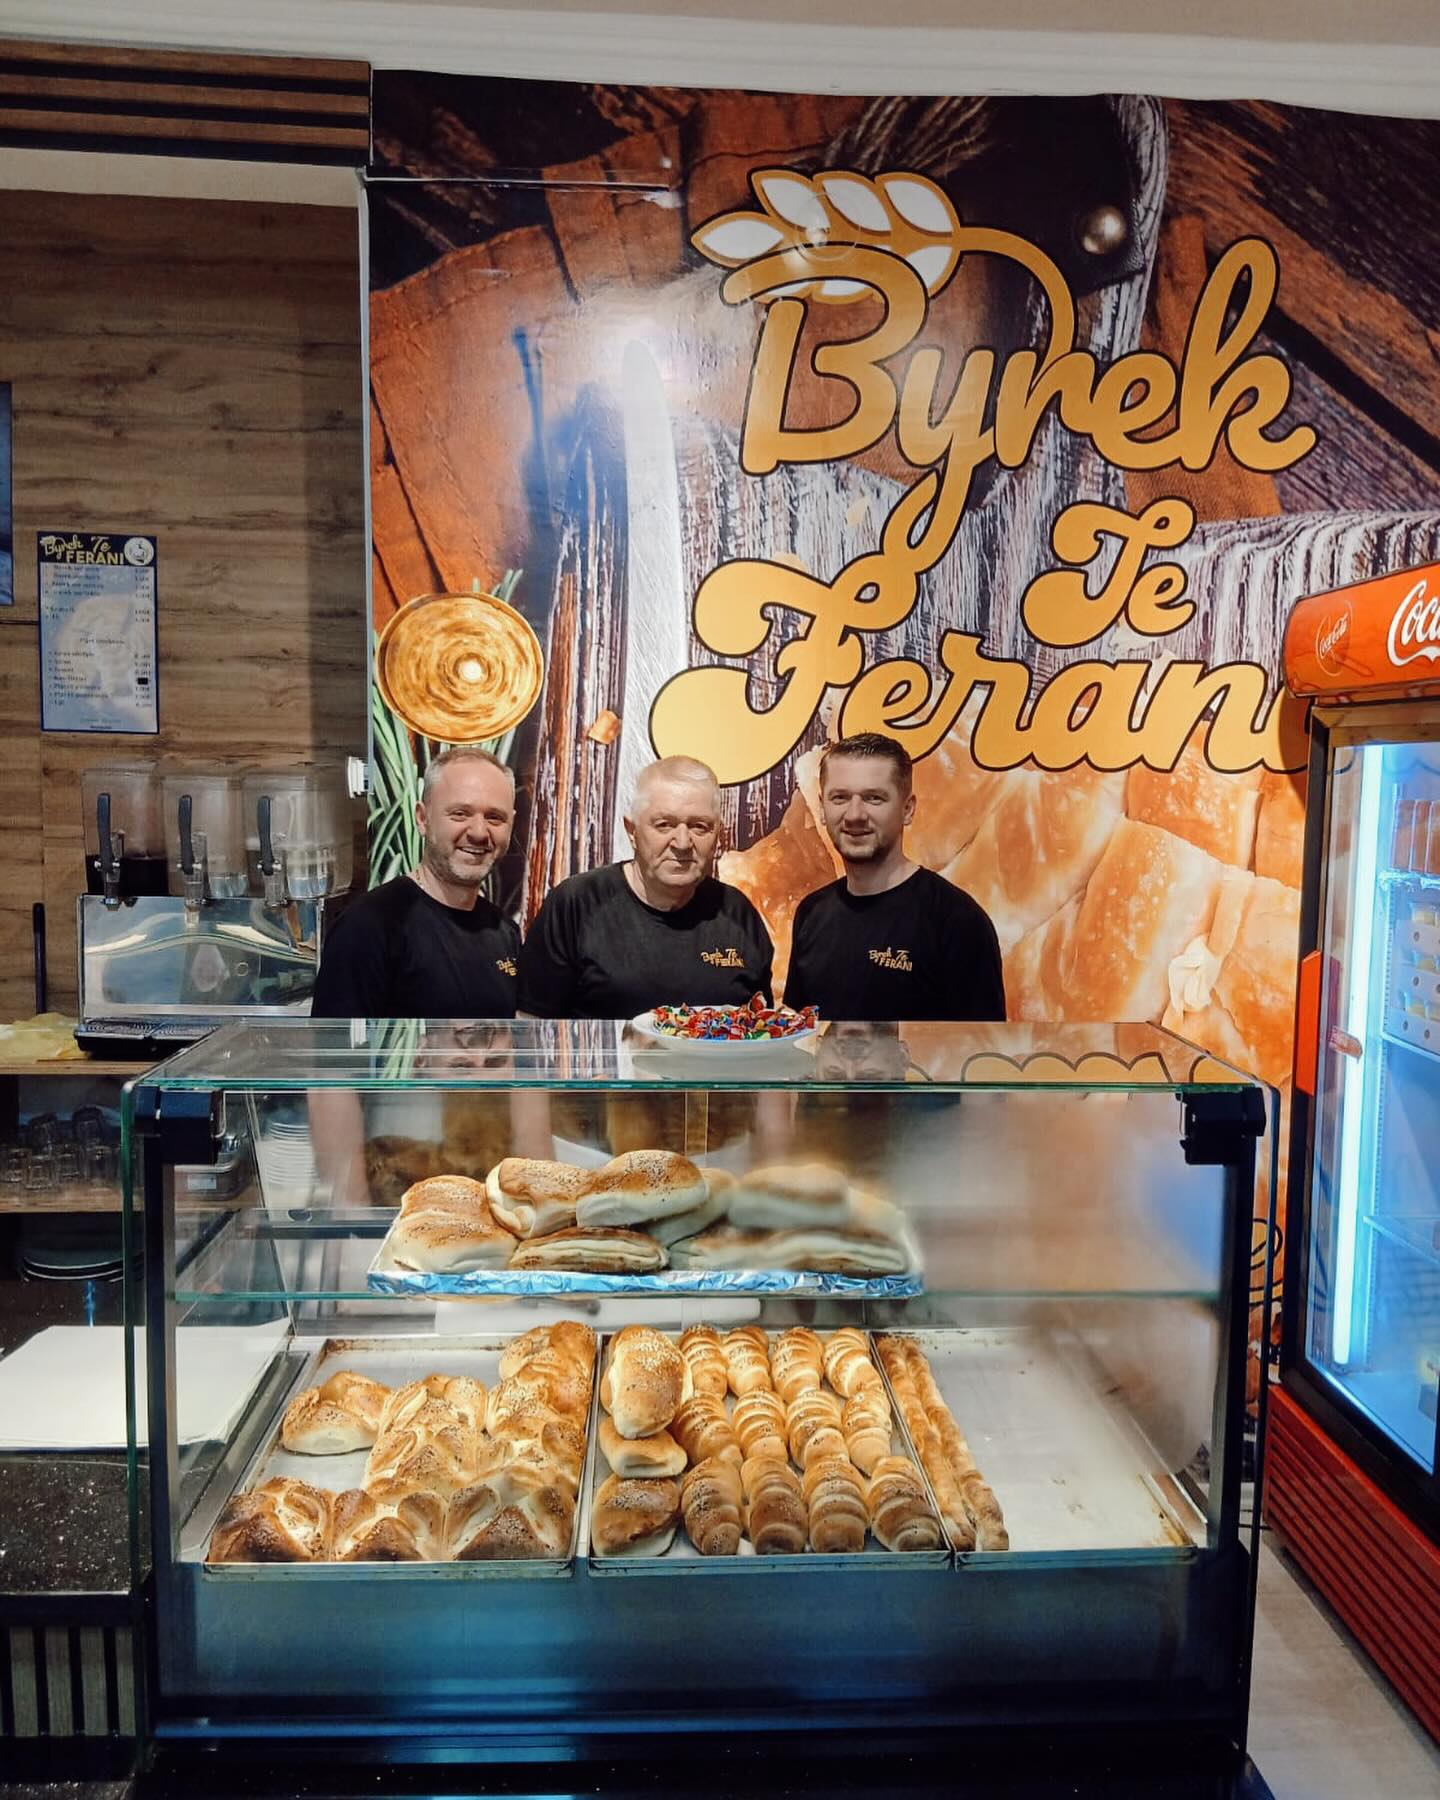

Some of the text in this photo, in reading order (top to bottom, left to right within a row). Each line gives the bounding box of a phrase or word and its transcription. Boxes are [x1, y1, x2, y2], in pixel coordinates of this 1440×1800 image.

[721, 237, 1318, 574] Byrek
[66, 550, 125, 565] FERANI
[91, 536, 111, 553] Te
[1021, 497, 1197, 646] Te
[649, 553, 1309, 786] Feran
